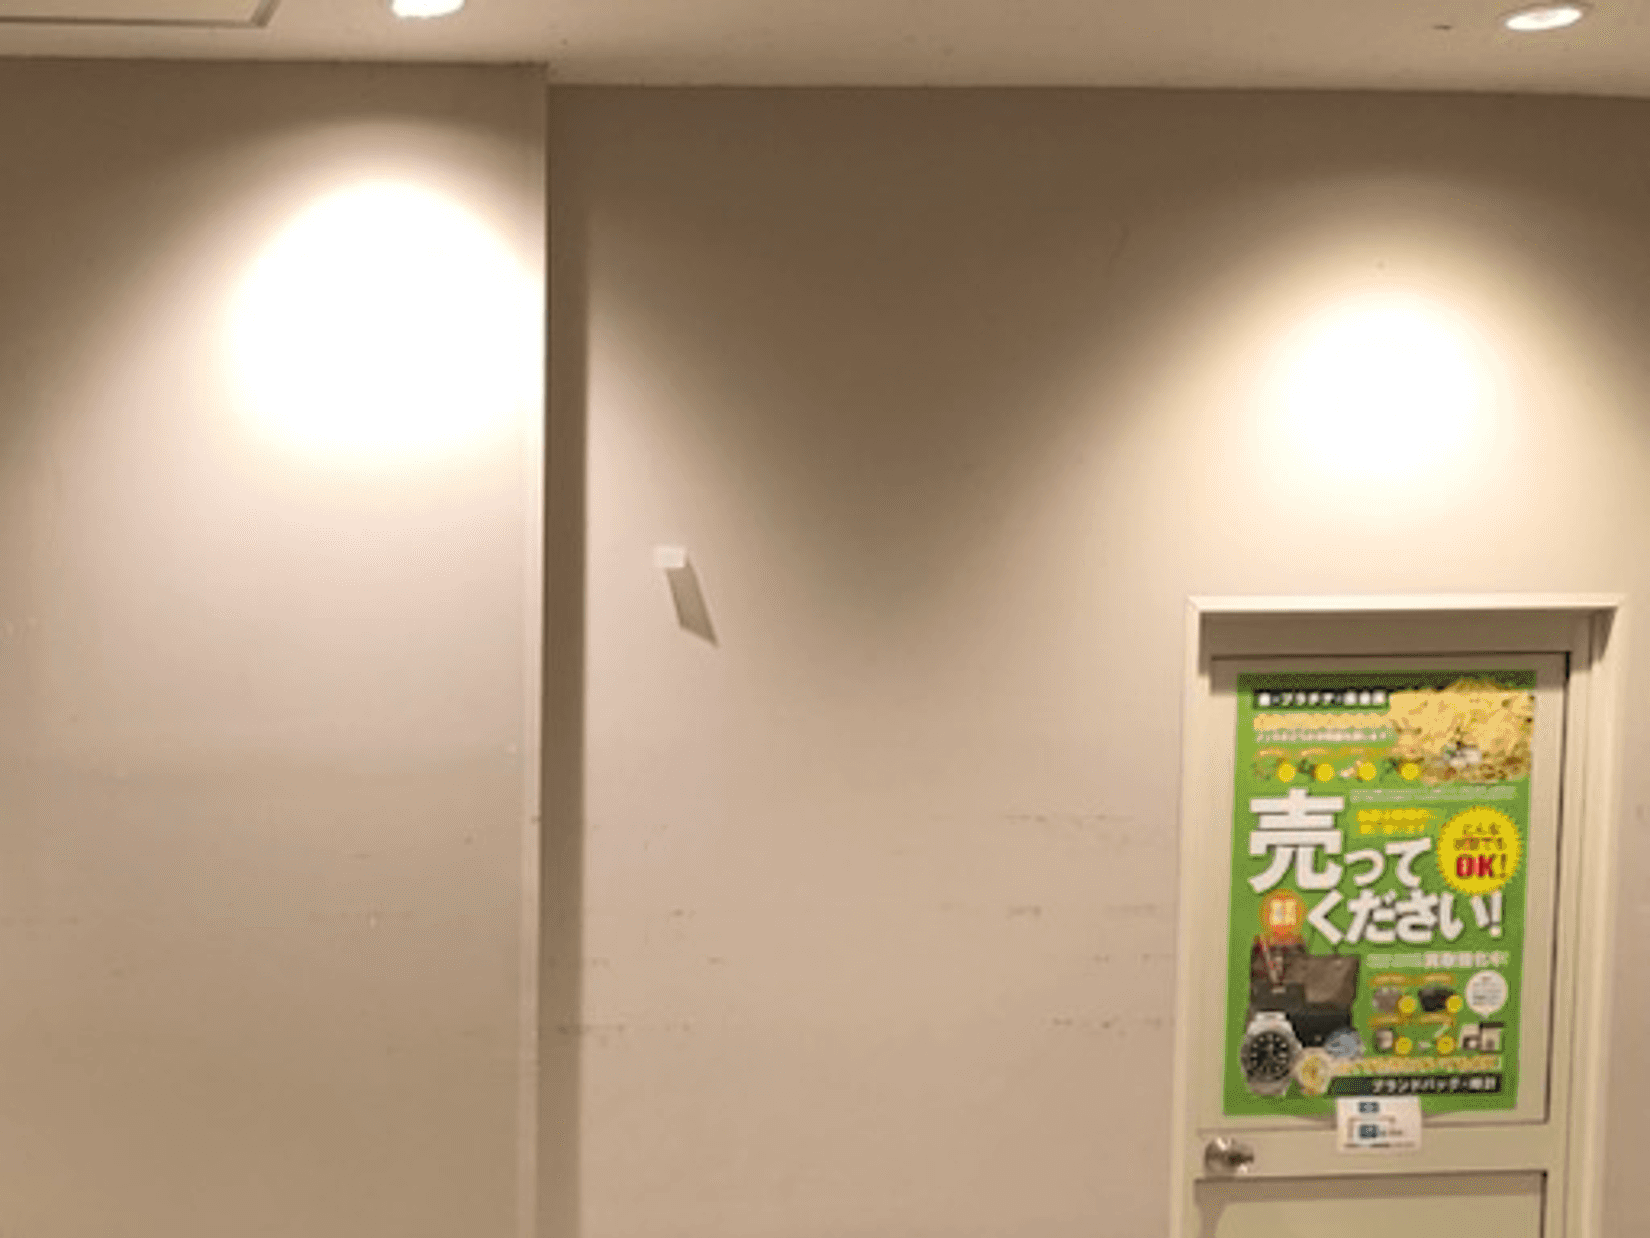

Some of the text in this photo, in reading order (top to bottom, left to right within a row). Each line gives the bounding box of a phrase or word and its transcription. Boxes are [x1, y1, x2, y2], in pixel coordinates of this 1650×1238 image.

[1248, 788, 1432, 893] 売って
[1456, 854, 1508, 881] OK!
[1307, 889, 1503, 945] ください!
